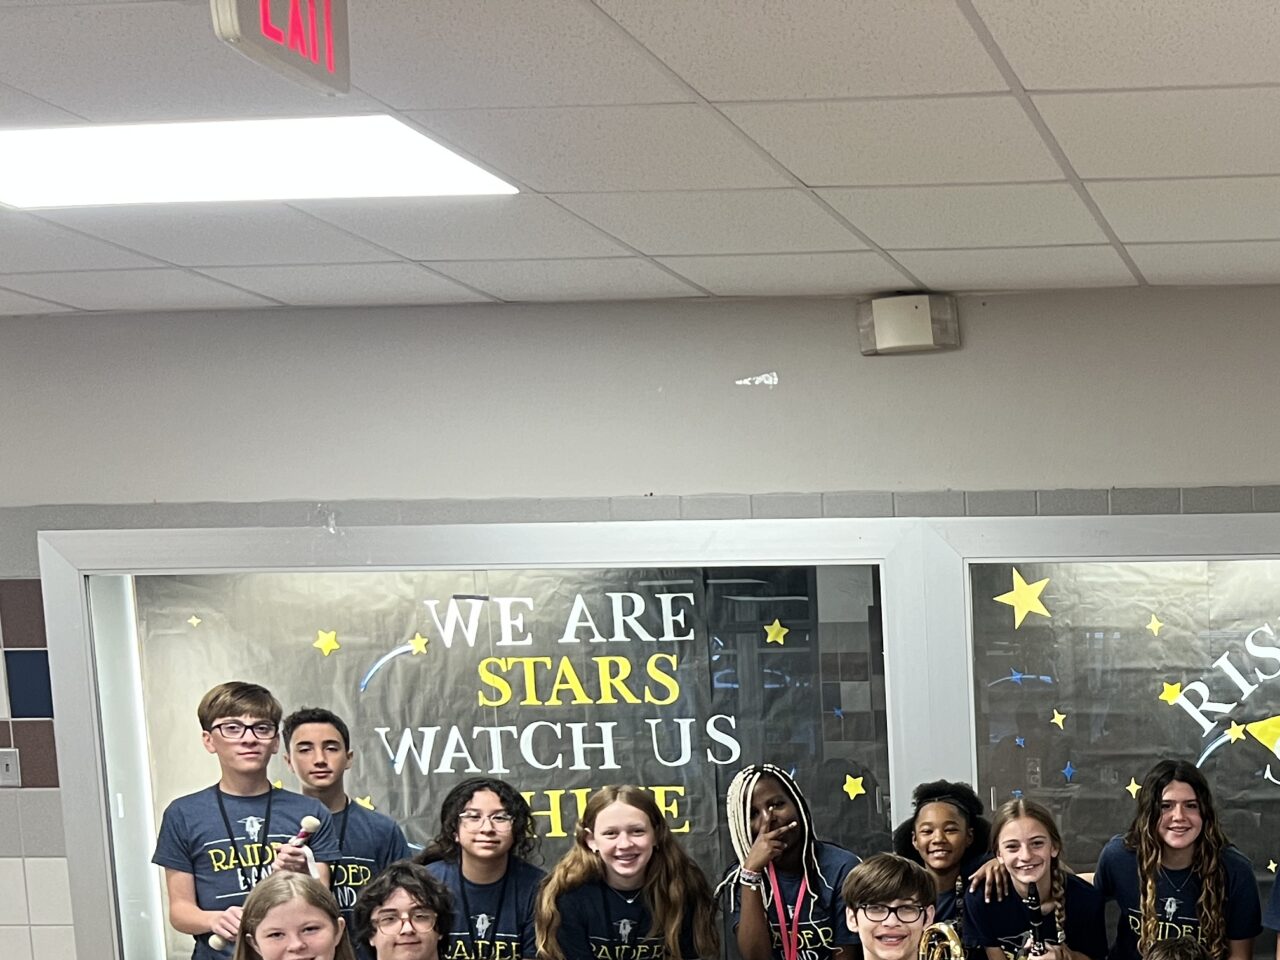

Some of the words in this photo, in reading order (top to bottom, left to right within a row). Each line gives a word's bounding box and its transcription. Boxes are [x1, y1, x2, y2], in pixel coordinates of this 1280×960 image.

[424, 597, 534, 648] WE
[558, 592, 695, 646] ARE
[478, 653, 680, 707] STARS
[375, 720, 622, 775] WATCH
[645, 715, 742, 767] US
[519, 786, 690, 838] HIE
